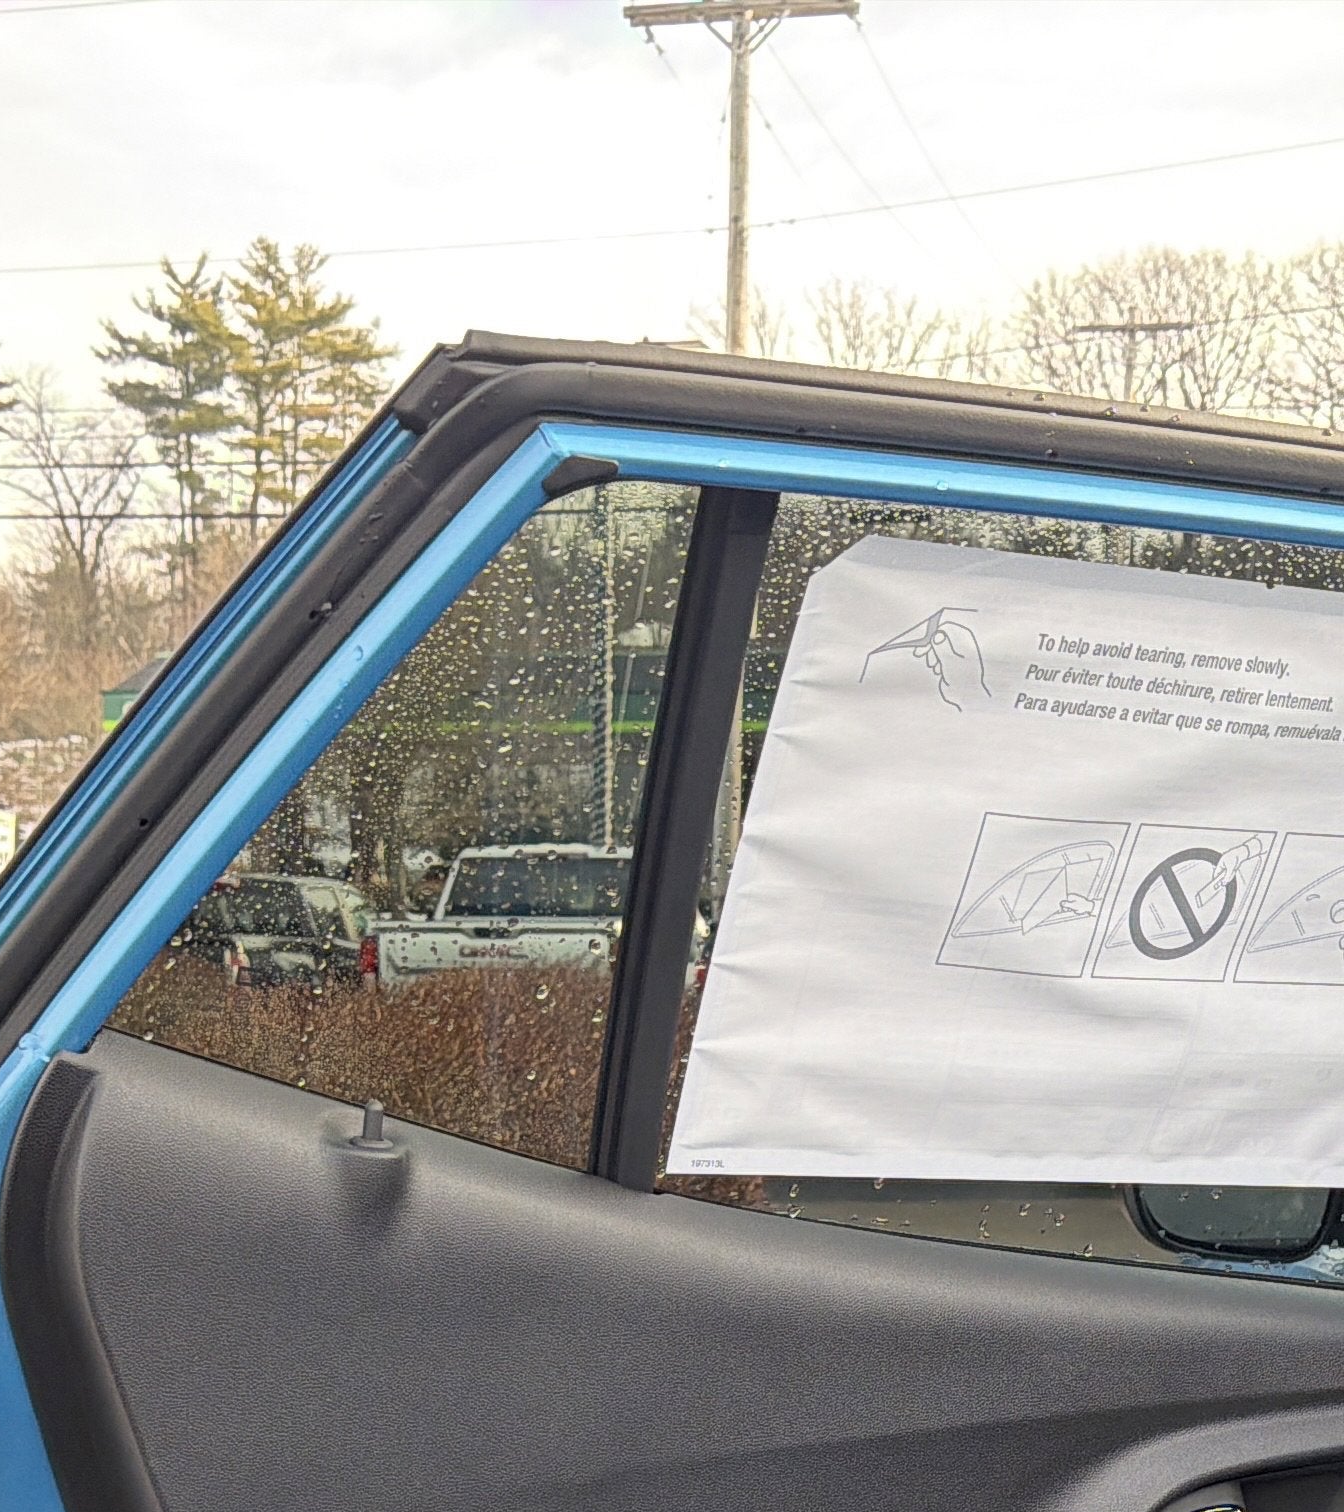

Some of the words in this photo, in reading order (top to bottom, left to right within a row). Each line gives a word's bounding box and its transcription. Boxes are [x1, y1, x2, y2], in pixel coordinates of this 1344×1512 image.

[1037, 633, 1055, 652] To
[1058, 635, 1090, 658] help
[1092, 641, 1133, 660] avoid
[1135, 644, 1186, 668] tearing,
[1190, 653, 1243, 671] remove
[1245, 656, 1290, 679] slowly.
[1025, 664, 1060, 683] Pour
[1062, 667, 1104, 687] éviter
[1106, 672, 1143, 691] toute
[1146, 676, 1215, 703] déchirure,
[1220, 687, 1264, 706] retirer
[1265, 689, 1334, 713] lentement.
[1014, 692, 1048, 711] Para
[1050, 698, 1117, 719] ayudarse
[1119, 708, 1130, 721] a
[1132, 708, 1174, 726] evitar
[1175, 713, 1203, 731] que
[1205, 717, 1223, 733] se
[1225, 719, 1270, 739] rompa,
[1274, 724, 1342, 742] remuévala
